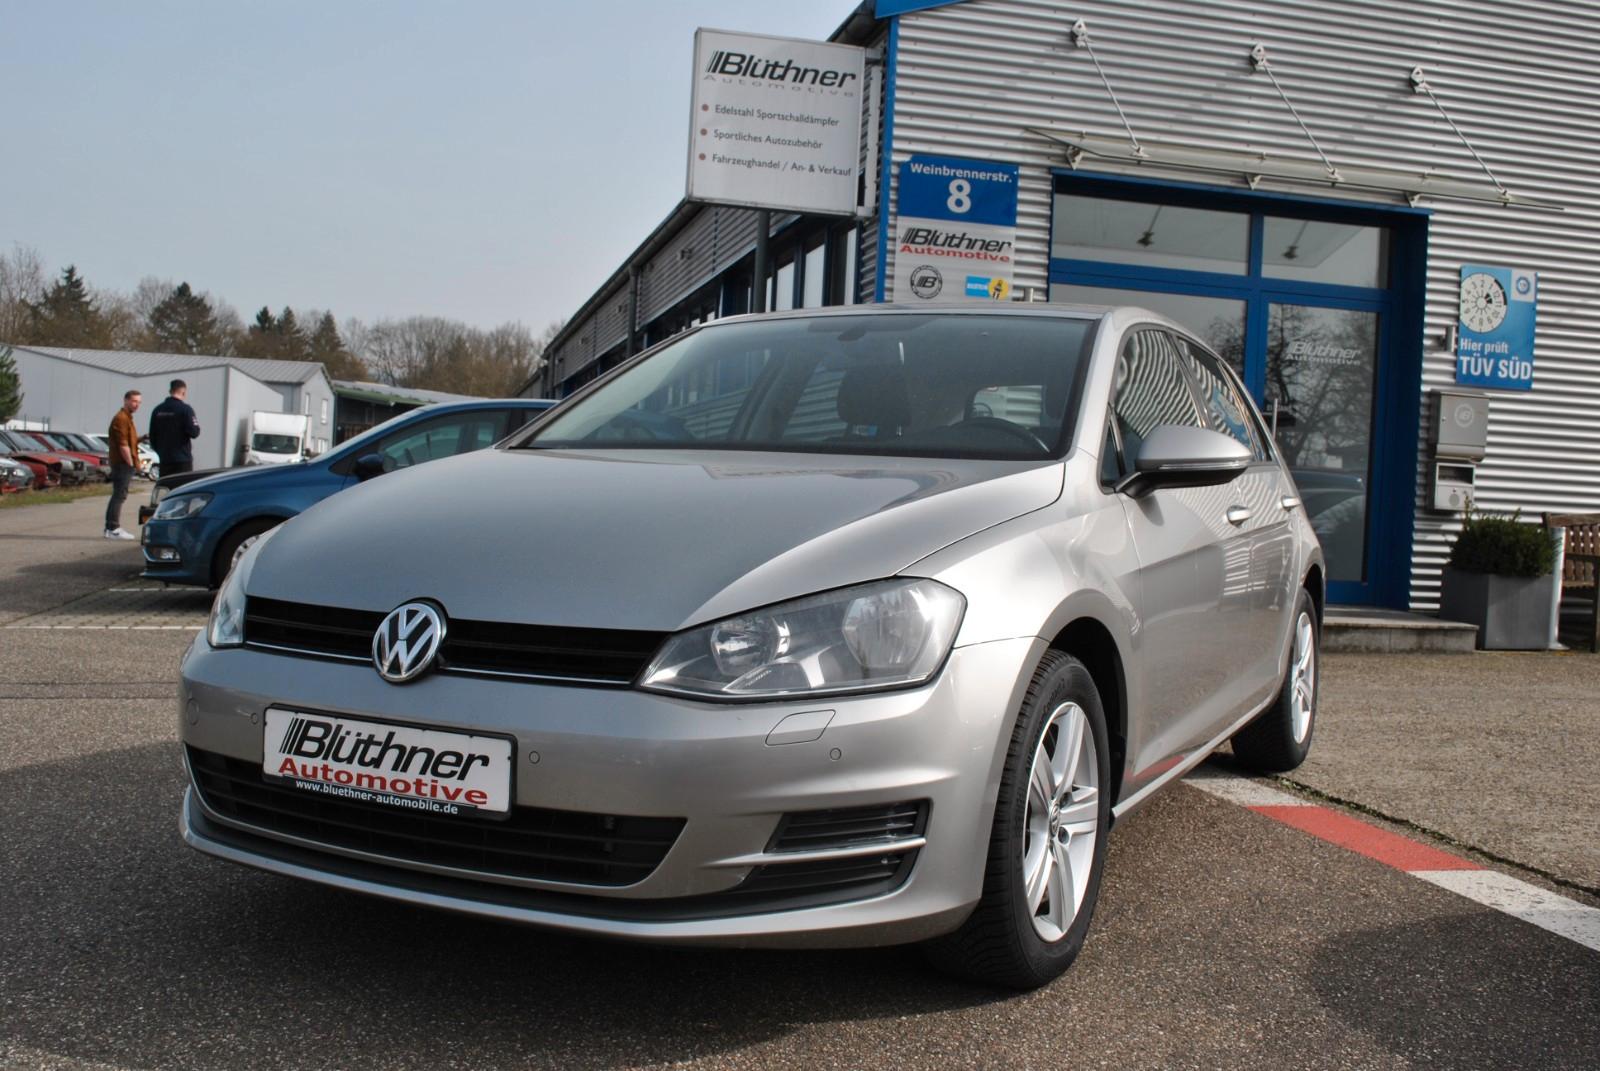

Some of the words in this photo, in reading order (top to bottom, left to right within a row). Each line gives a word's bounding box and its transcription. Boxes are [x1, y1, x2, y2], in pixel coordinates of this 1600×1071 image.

[707, 50, 856, 88] Blüthner
[703, 74, 854, 97] Automotive
[715, 104, 754, 117] Edelstahl
[756, 109, 840, 127] Sportschalldämpfer
[713, 129, 762, 144] Sportliches
[764, 135, 823, 149] Autozubehör
[712, 154, 780, 170] Fahrzeughandel
[791, 162, 806, 171] An-
[808, 164, 815, 173] &
[818, 166, 852, 177] Verkauf
[911, 163, 1012, 183] Weinbrennerstr.
[947, 178, 972, 214] 8
[901, 227, 1012, 253] Blüthner
[900, 245, 1010, 263] Automotive
[1460, 338, 1482, 351] Hier
[1484, 341, 1509, 355] prüft
[1459, 352, 1495, 377] TÜV
[1498, 356, 1532, 380] SÜD
[279, 717, 490, 780] Blüthner
[278, 757, 488, 805] Automotive
[296, 780, 459, 815] www.bluethner-automobile.de
